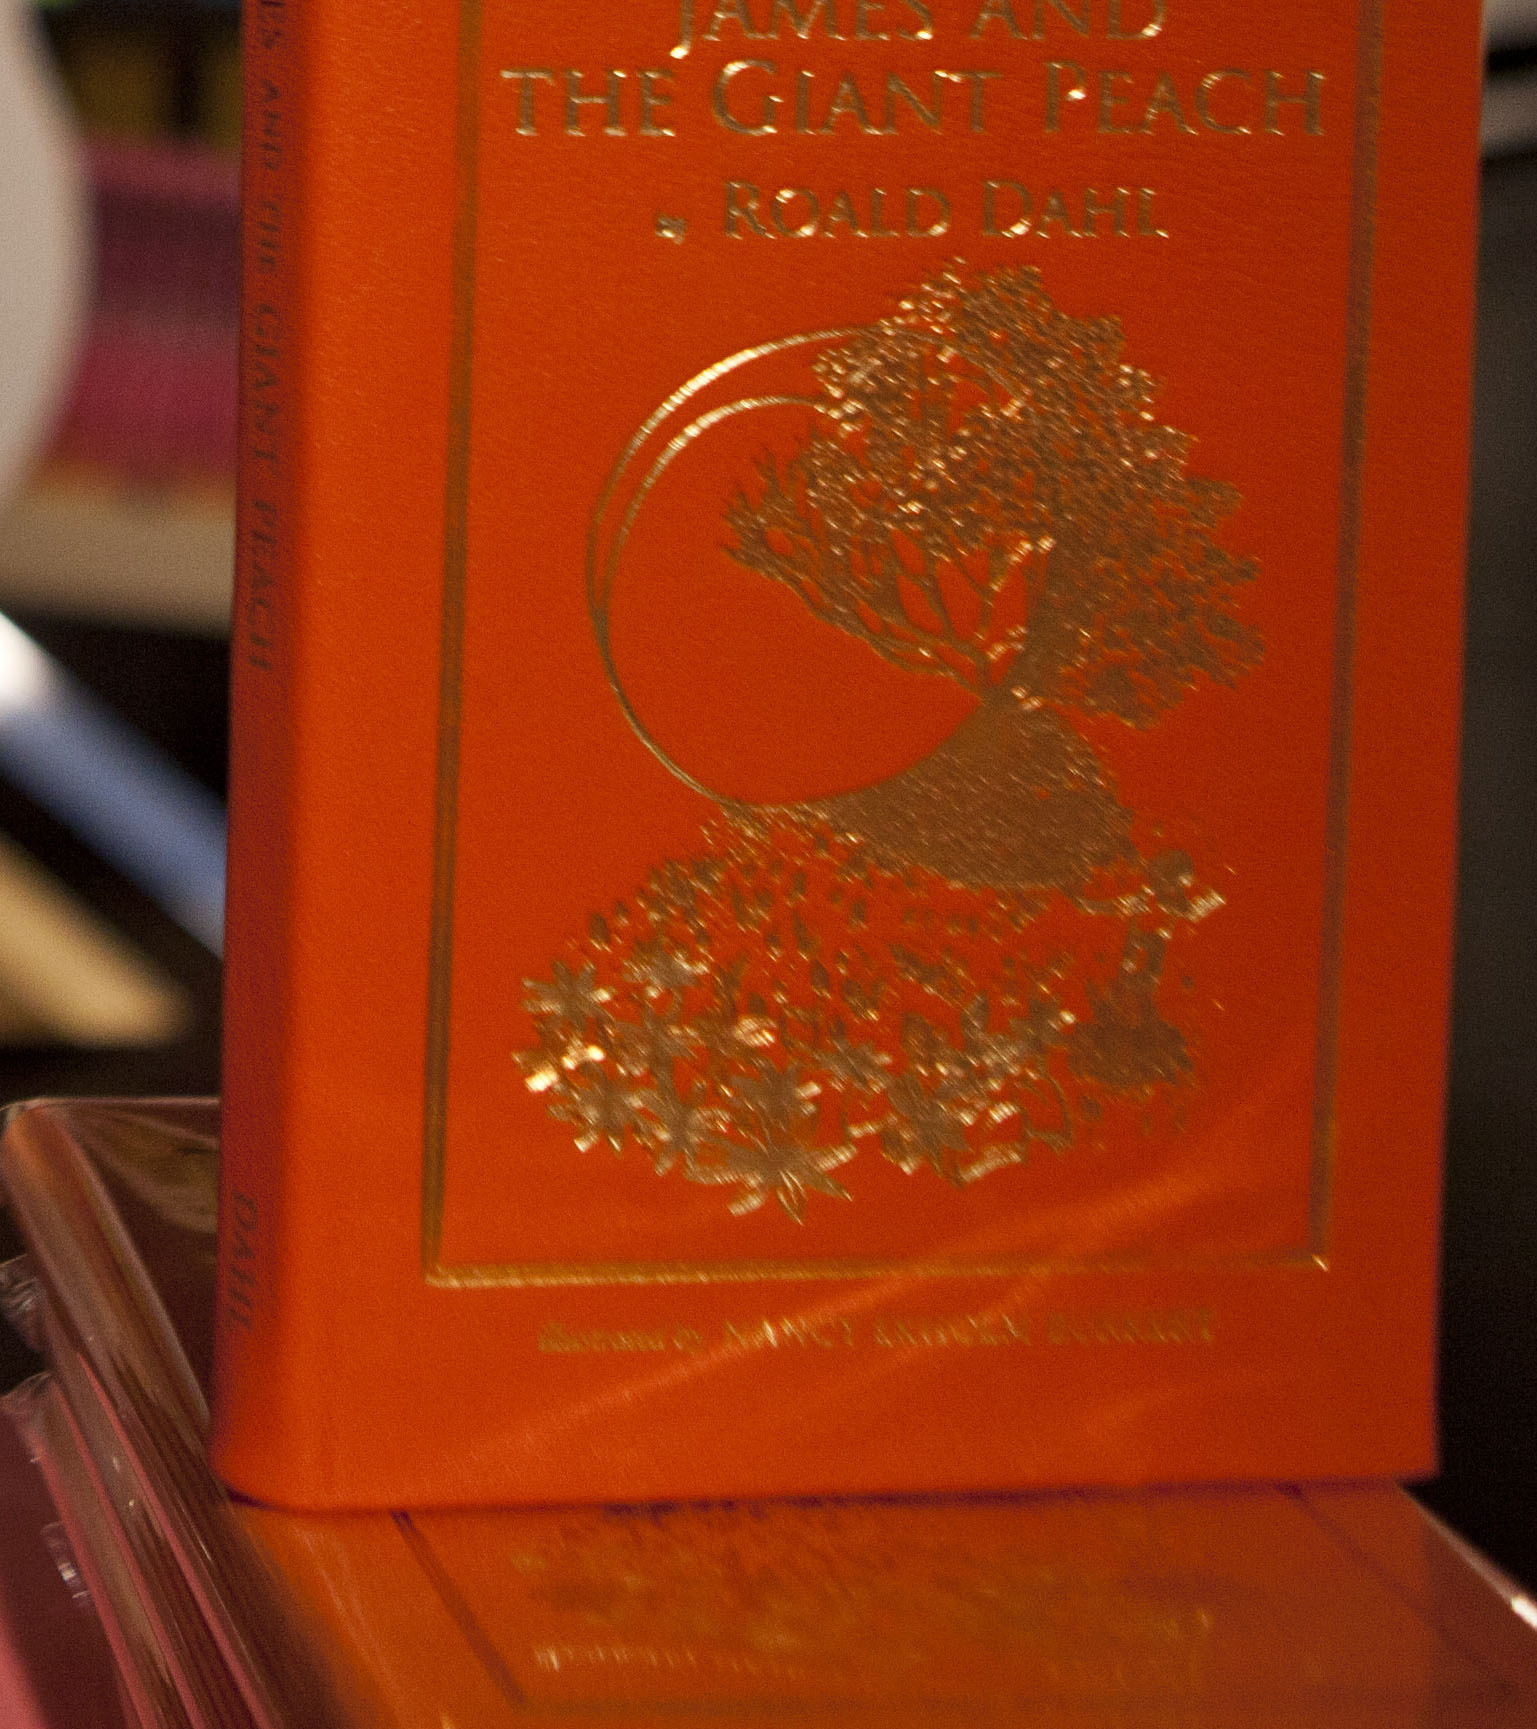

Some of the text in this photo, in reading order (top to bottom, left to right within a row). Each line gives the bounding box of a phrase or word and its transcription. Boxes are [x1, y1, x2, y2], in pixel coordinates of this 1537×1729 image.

[259, 78, 282, 172] AND
[500, 59, 1325, 138] THE GIANT PEACH
[726, 179, 950, 239] ROALD
[982, 179, 1169, 239] DAHL
[253, 301, 281, 471] GIANT
[246, 497, 279, 672] PEACH
[228, 1189, 258, 1331] DAHL
